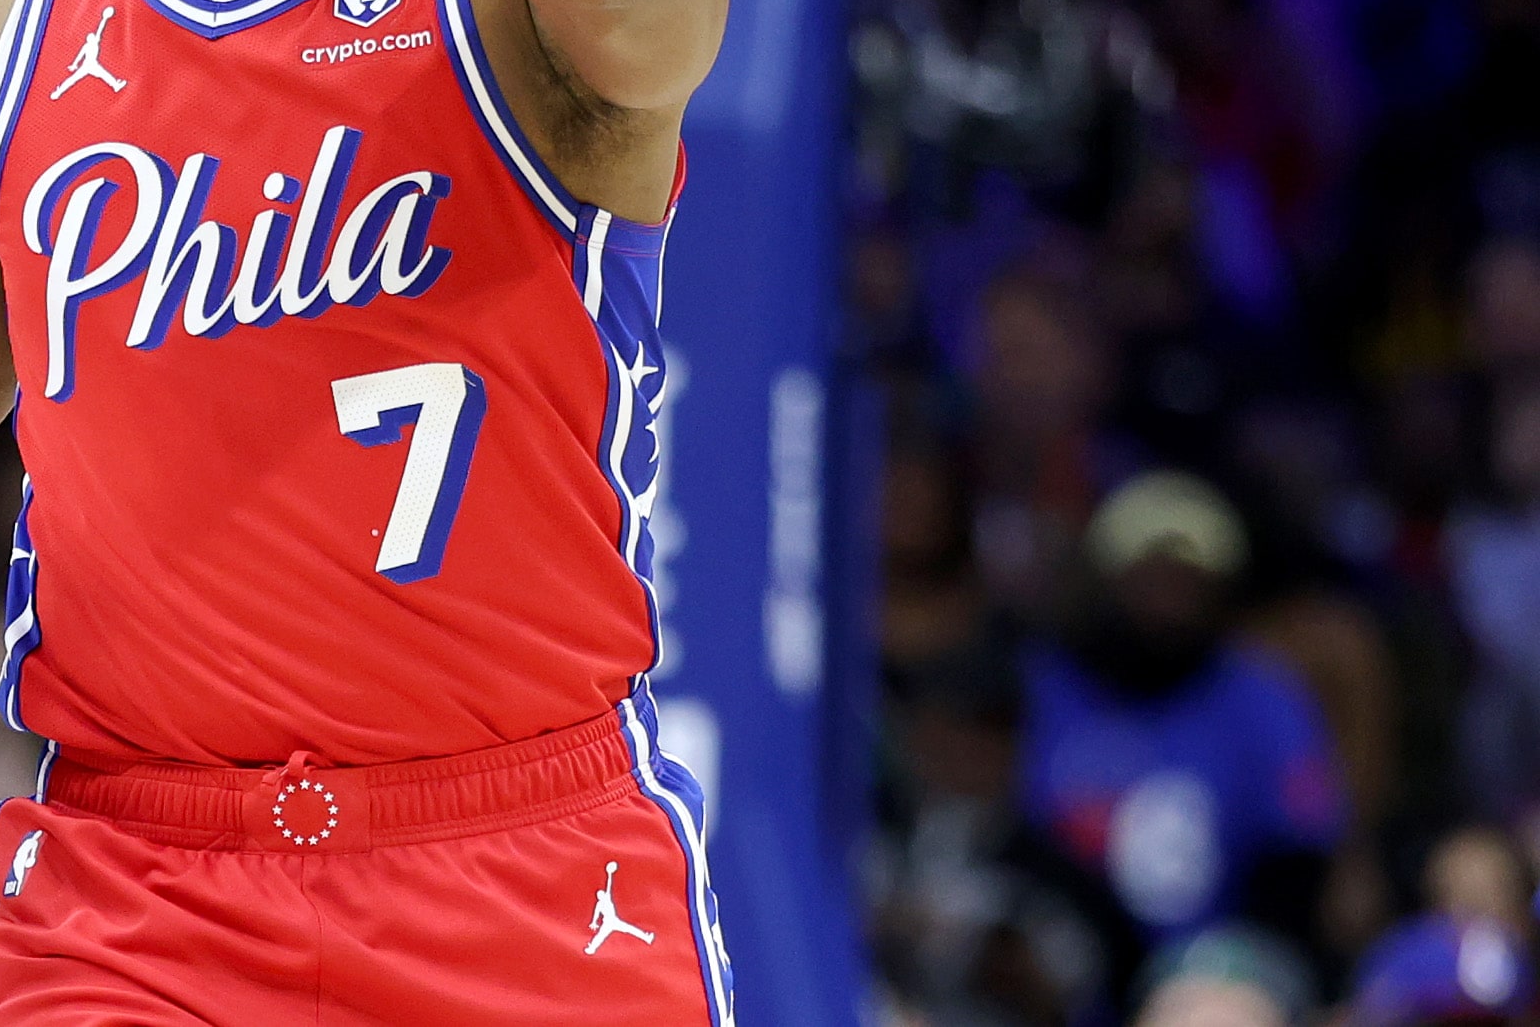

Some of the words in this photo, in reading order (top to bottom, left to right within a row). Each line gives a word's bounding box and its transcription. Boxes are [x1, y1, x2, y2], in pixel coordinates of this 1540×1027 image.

[301, 30, 432, 64] crypto.com
[23, 125, 451, 403] Phila
[331, 362, 487, 585] 7
